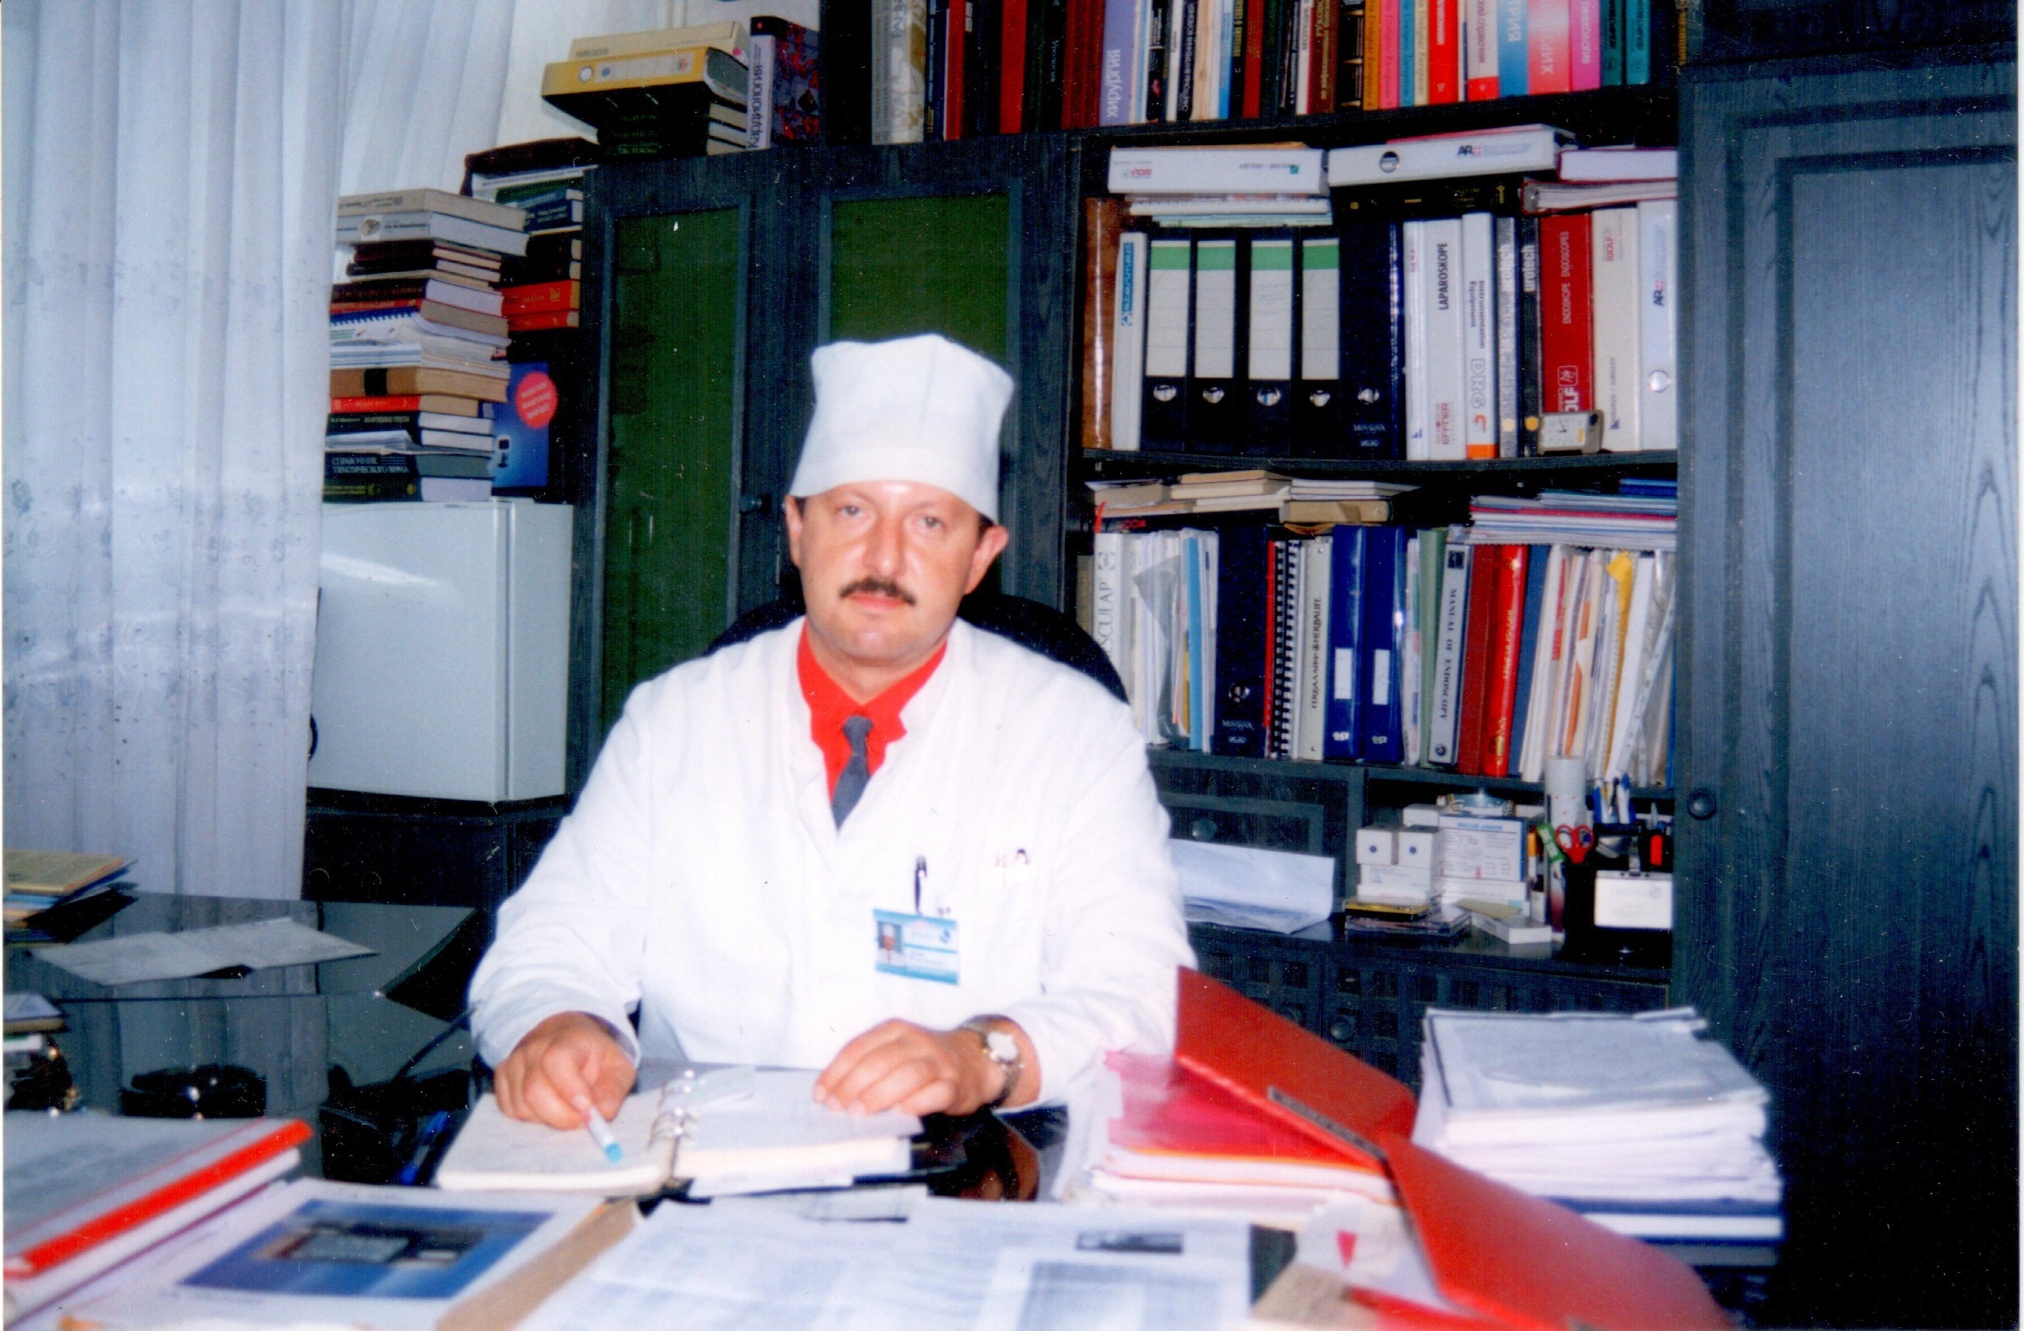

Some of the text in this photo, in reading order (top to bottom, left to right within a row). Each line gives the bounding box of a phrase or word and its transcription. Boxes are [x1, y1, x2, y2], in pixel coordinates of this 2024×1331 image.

[747, 65, 763, 149] Кардиология
[1105, 49, 1122, 117] хирургия
[1498, 244, 1513, 292] urotech
[1521, 244, 1536, 293] urotech
[1606, 237, 1614, 262] WOLF
[1437, 242, 1449, 310] LAPAROSKOPE
[1468, 281, 1477, 327] Equipment
[1561, 282, 1571, 324] ENDOSKOPE
[1471, 358, 1486, 409] DRG
[1313, 598, 1321, 642] HERBALIFE
[1439, 589, 1458, 720] MANUAL OF ENDOSCOPY
